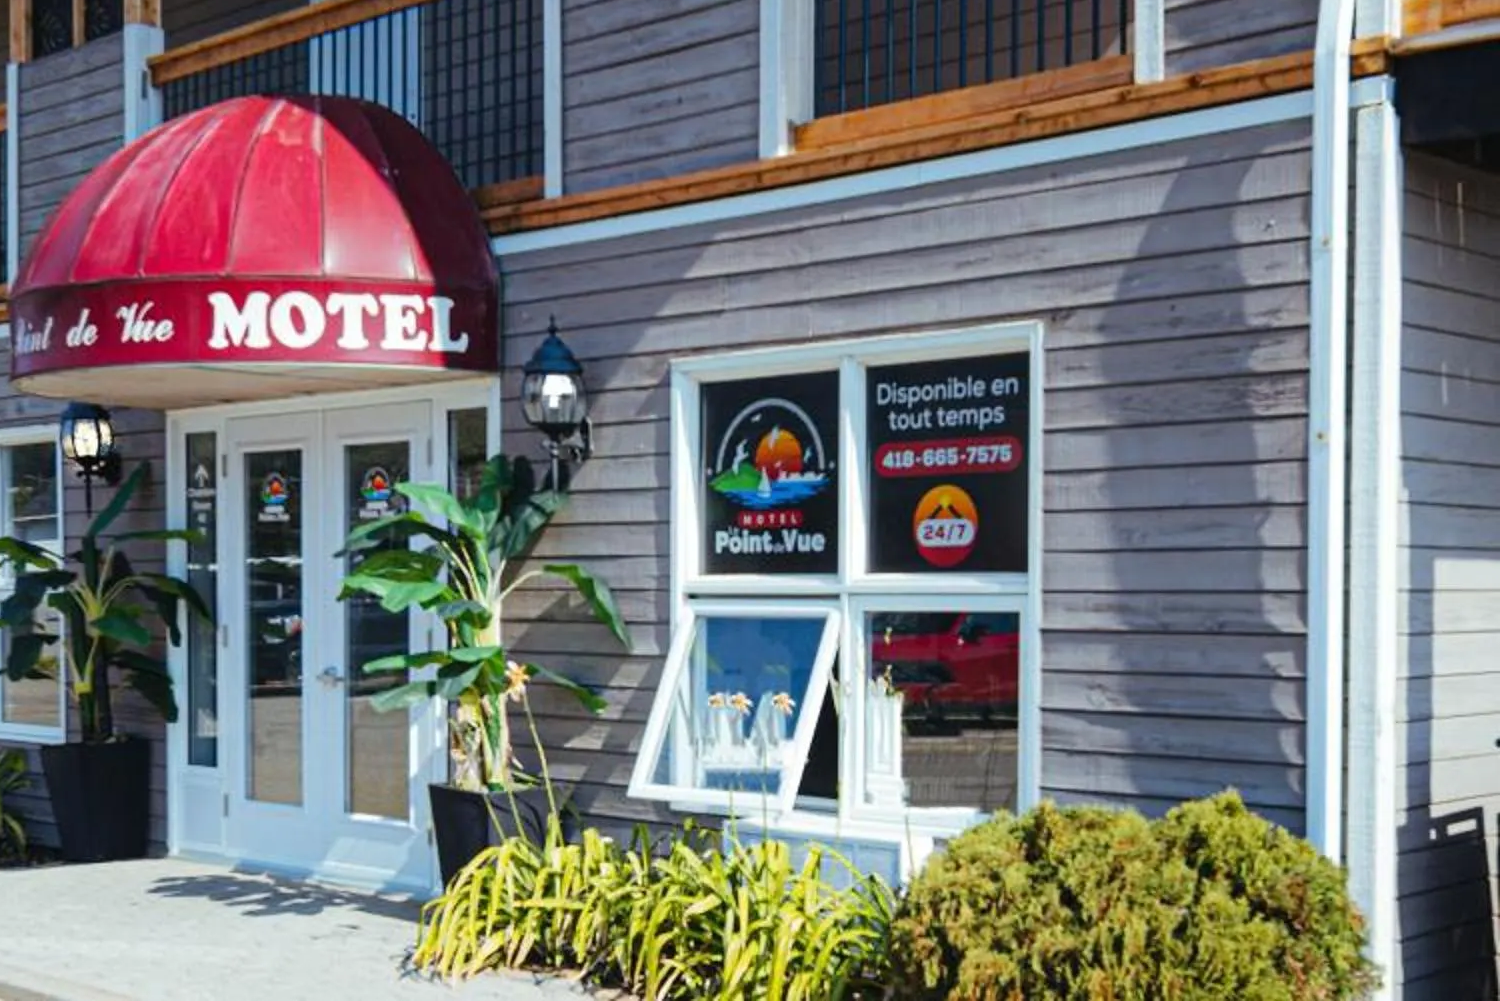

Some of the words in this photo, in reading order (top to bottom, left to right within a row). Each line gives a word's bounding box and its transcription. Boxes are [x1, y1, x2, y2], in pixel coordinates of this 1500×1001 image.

[66, 308, 99, 347] de
[116, 301, 175, 343] Vue
[207, 290, 469, 354] MOTEL
[876, 375, 986, 409] Disponible
[991, 377, 1019, 397] en
[888, 409, 932, 431] tout
[937, 406, 1005, 431] temps
[743, 511, 797, 525] MOTEL
[715, 528, 772, 554] Point
[781, 528, 826, 552] Vue
[923, 523, 965, 541] 24/7
